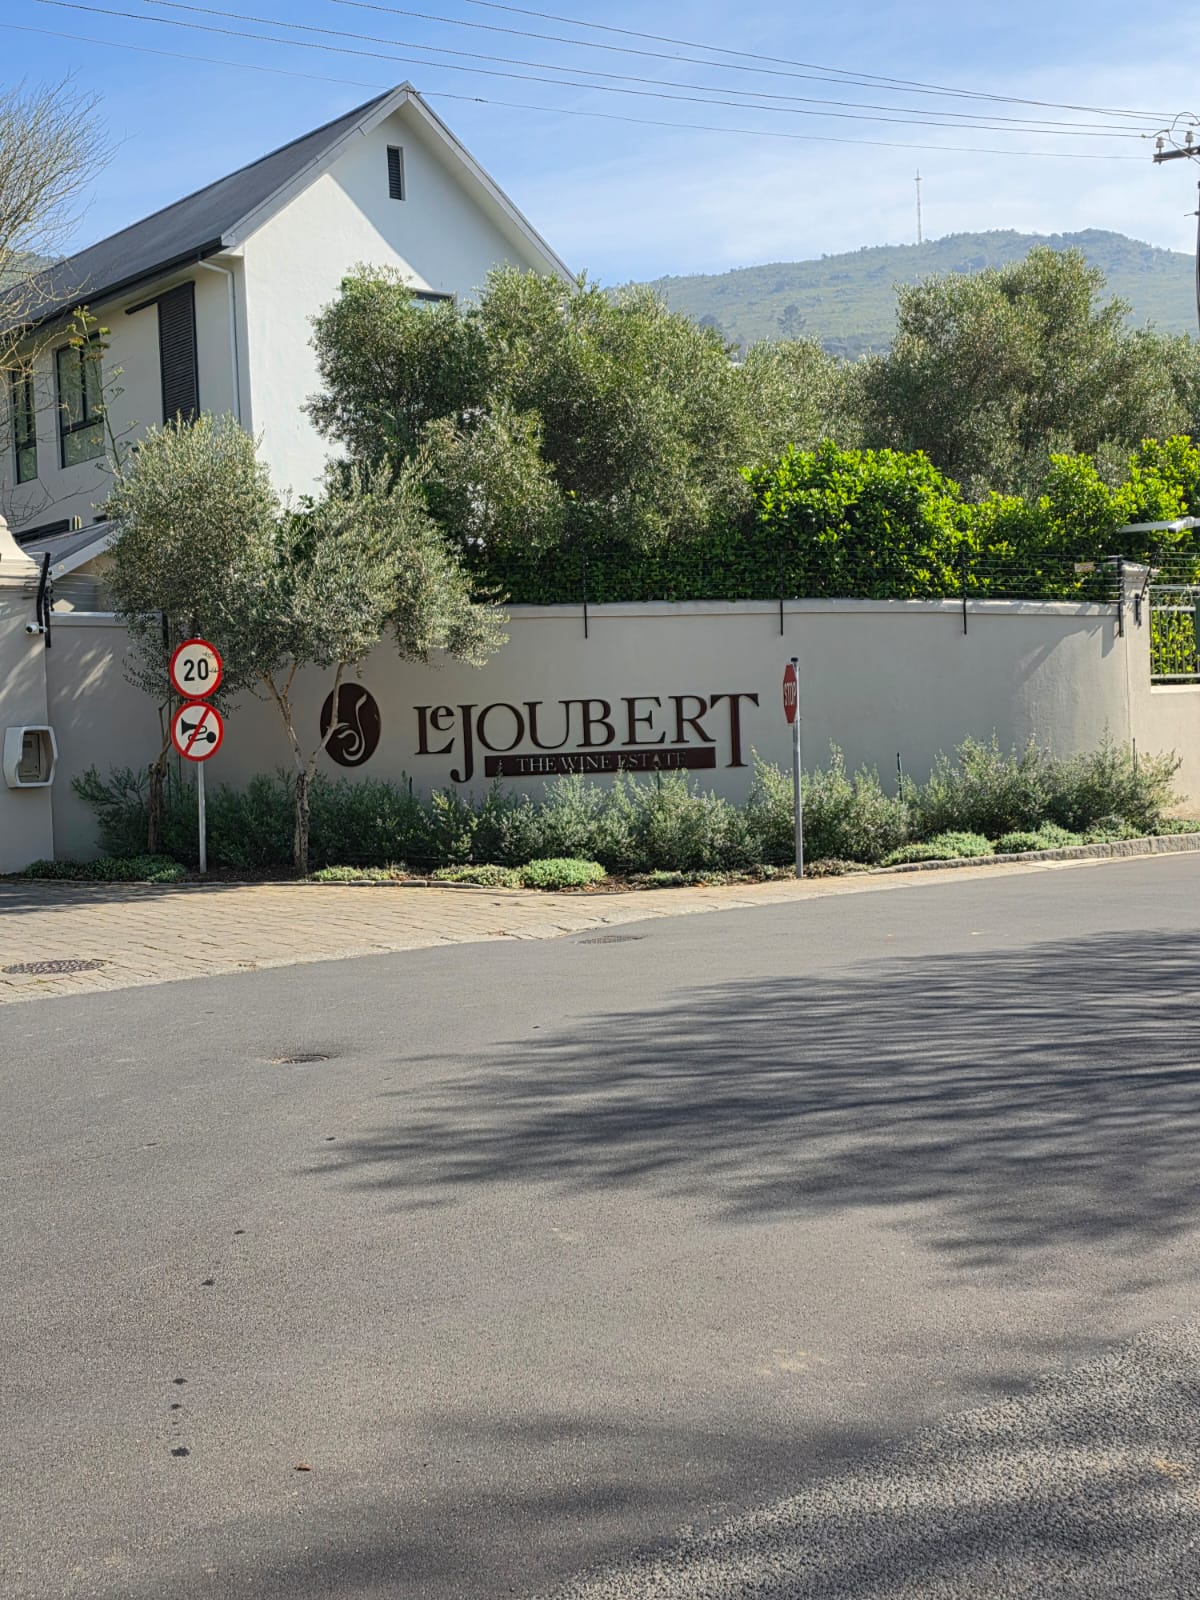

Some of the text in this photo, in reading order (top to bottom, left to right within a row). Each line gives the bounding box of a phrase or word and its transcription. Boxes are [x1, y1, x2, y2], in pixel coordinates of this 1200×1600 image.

[183, 658, 209, 682] 20
[784, 681, 797, 706] STOP
[516, 751, 687, 772] THE WINE ESTATE
